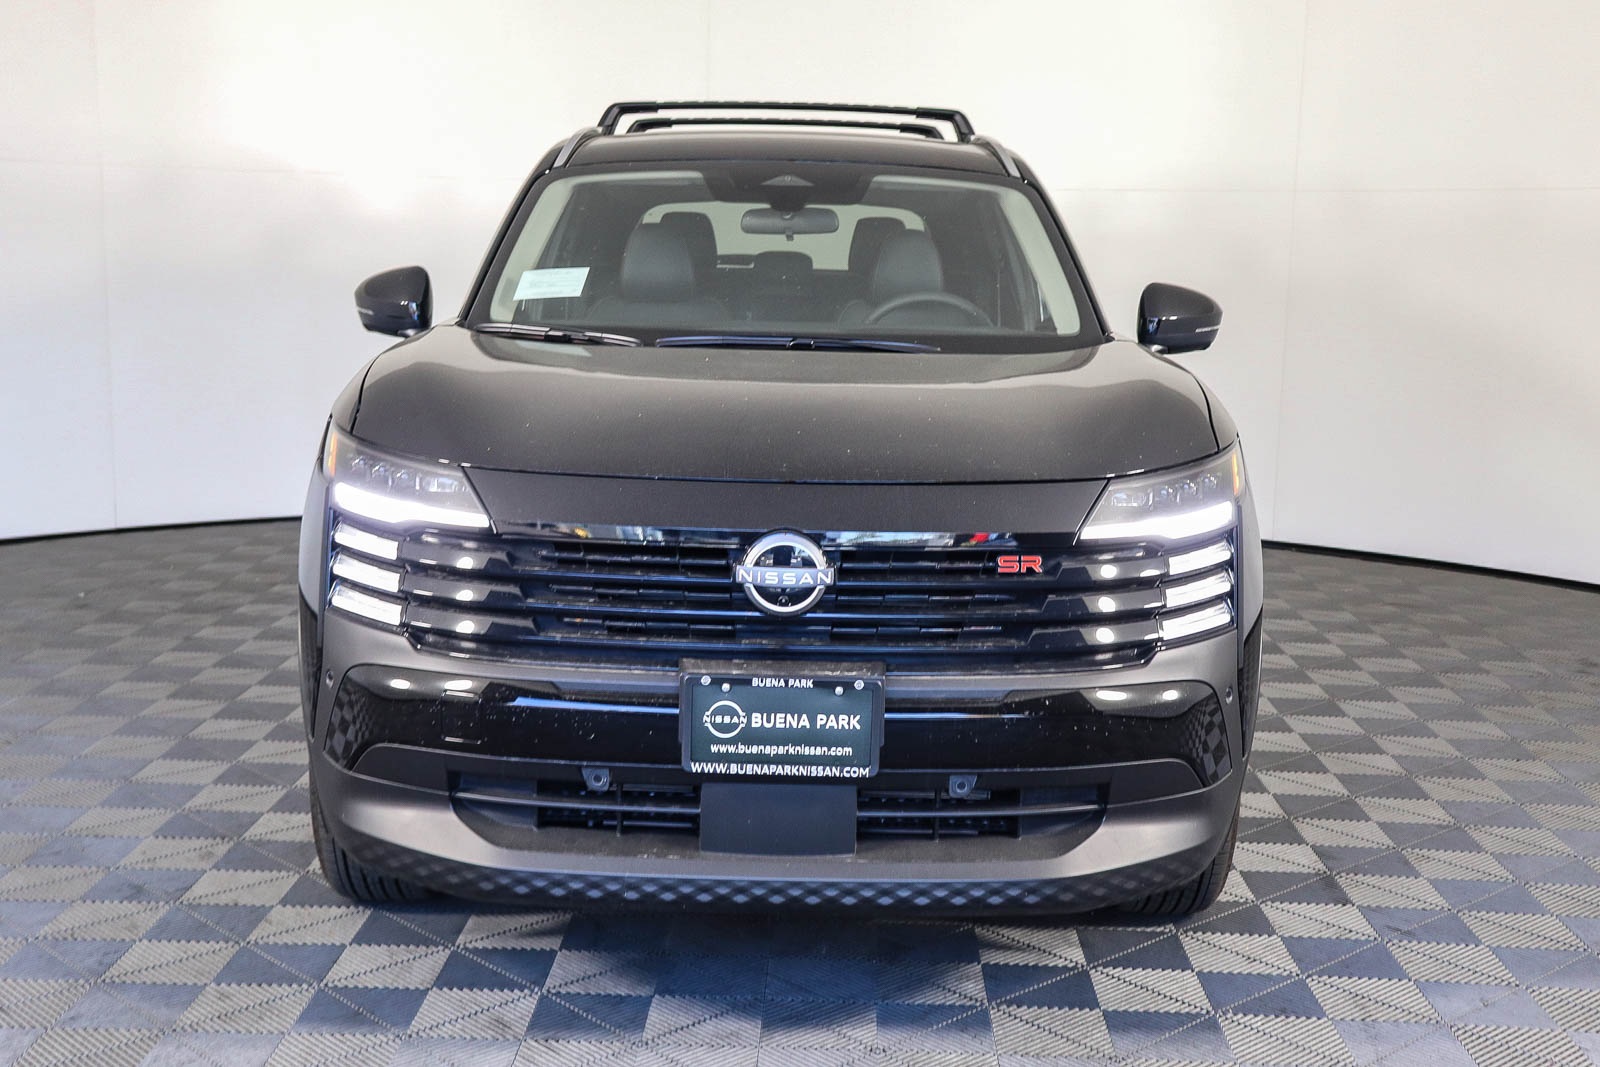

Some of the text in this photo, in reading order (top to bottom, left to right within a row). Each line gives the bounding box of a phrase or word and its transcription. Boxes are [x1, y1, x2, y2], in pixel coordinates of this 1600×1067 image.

[997, 555, 1043, 573] SR
[739, 569, 832, 585] NISSAN
[752, 677, 814, 689] BUENA PARK
[702, 714, 748, 725] NISSAN
[751, 712, 861, 730] BUENA PARK
[710, 742, 853, 757] www.buenaparknissan.com
[690, 761, 869, 778] WWW.BUENAPARKNISSAN.COM
